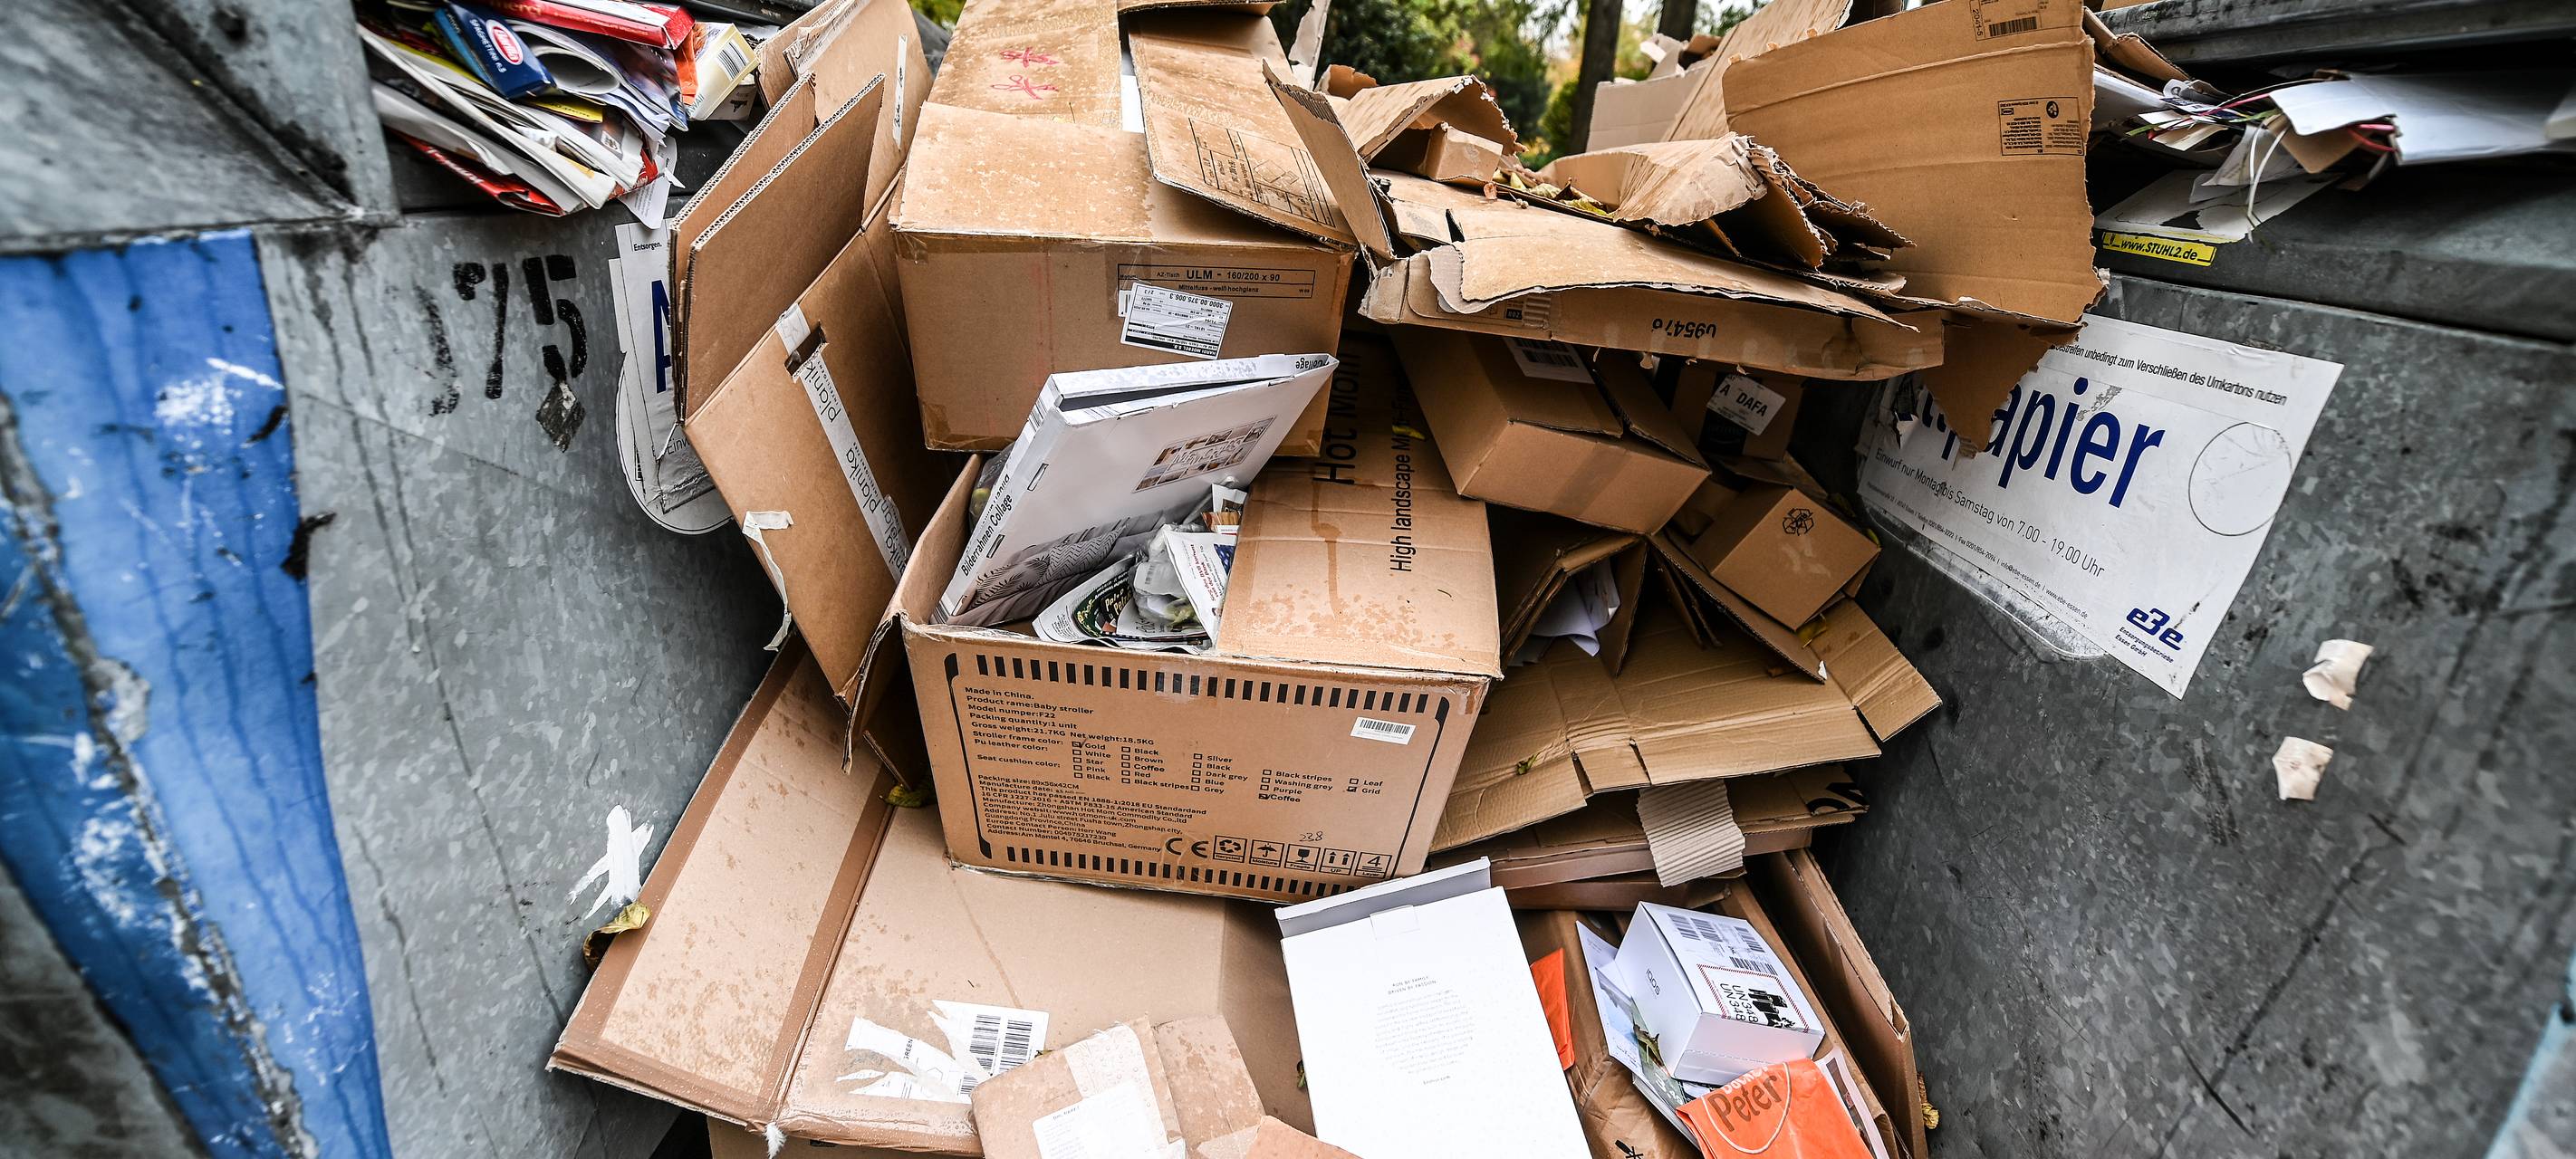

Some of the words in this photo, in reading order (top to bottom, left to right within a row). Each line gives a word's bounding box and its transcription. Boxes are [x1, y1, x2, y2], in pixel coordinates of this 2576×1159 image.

[632, 240, 663, 252] Entsorgen.
[2120, 240, 2198, 261] www.STUHL2.de
[1186, 270, 1213, 280] ULM
[1226, 272, 1259, 281] 160/200
[1270, 273, 1280, 282] 90
[2084, 350, 2118, 367] unbedingt
[2118, 357, 2135, 369] zum
[2137, 359, 2187, 382] Verschließen
[2189, 371, 2205, 386] des
[2206, 374, 2255, 398] Umkartons
[2254, 388, 2288, 407] nutzen
[1736, 391, 1768, 417] DAFA
[845, 446, 879, 514] planika
[1390, 453, 1417, 531] landscape
[1875, 447, 1903, 471] Einwurf
[1900, 464, 1916, 476] nur
[1915, 467, 1942, 498] Montag
[1954, 489, 1994, 524] Samstag
[1996, 513, 2015, 532] von
[2016, 520, 2041, 543] 7.00
[2050, 538, 2081, 565] 19.00
[2081, 553, 2105, 577] Uhr
[960, 526, 997, 577] Bilderrahmen
[990, 492, 1014, 528] Collage
[1389, 541, 1417, 572] High
[2044, 589, 2089, 619] www.ebe-essen.de
[965, 686, 991, 695] Made
[1004, 690, 1034, 700] China.
[966, 695, 1004, 705] Product
[1059, 706, 1094, 714] stroller
[967, 704, 996, 713] Model
[969, 713, 1006, 723] Packing
[971, 721, 997, 729] Gross
[972, 730, 1007, 739] Stroller
[1008, 733, 1036, 742] frame
[987, 741, 1020, 749] leather
[1084, 742, 1107, 751] Gold
[1085, 751, 1111, 759] White
[1134, 748, 1159, 756] Black
[998, 756, 1033, 765] cushion
[1034, 760, 1061, 769] color:
[1134, 755, 1164, 764] Brown
[1206, 755, 1233, 763] Silver
[1133, 763, 1166, 772] Coffee
[1206, 763, 1232, 771] Black
[977, 774, 1011, 783] Packing
[1275, 771, 1300, 779] Black
[1302, 773, 1332, 782] stripes
[979, 780, 1032, 790] Manufacture
[1134, 779, 1158, 787] Black
[1159, 781, 1190, 790] stripes
[1204, 786, 1225, 795] Grey
[1273, 786, 1302, 795] Purple
[1274, 778, 1312, 790] Washing
[1313, 783, 1333, 791] grey
[1270, 793, 1301, 803] Coffee
[983, 801, 1021, 810] Company
[983, 797, 1035, 807] Manufacture:
[1036, 802, 1080, 811] Zhongshan
[1116, 810, 1161, 821] Commodity
[1116, 804, 1155, 815] American
[1156, 809, 1193, 819] Standard
[1159, 803, 1206, 816] Standardand
[985, 813, 1030, 822] Guangdong
[1080, 817, 1102, 825] Fusha
[986, 823, 1018, 831] Contact
[1018, 827, 1053, 835] Number:
[1047, 824, 1077, 832] Person:
[1095, 829, 1117, 838] Wang
[1034, 833, 1061, 841] Mantel
[1092, 839, 1127, 848] Bruchsal,
[1128, 843, 1161, 852] Germany
[1367, 856, 1381, 867] 4
[1645, 968, 1661, 996] IQOS
[1707, 1075, 1782, 1133] Peter
